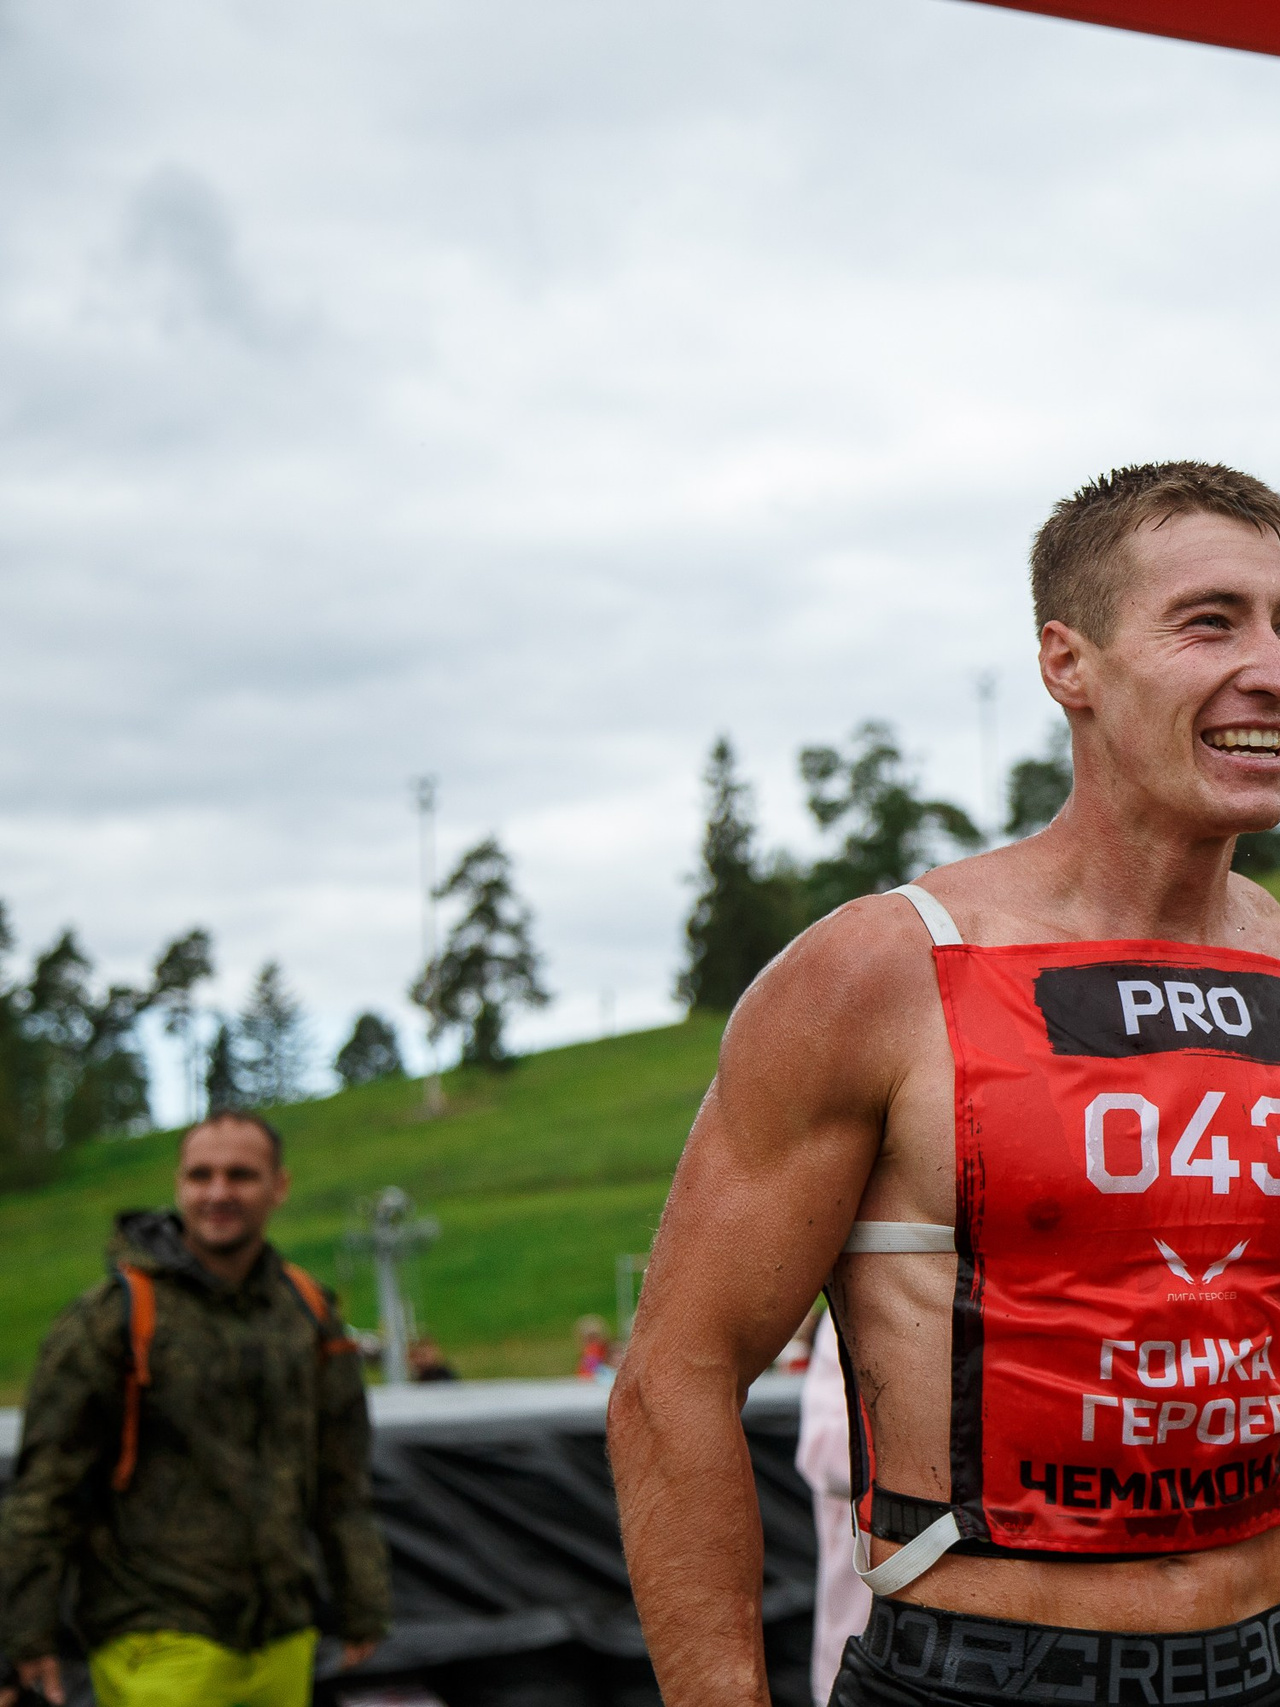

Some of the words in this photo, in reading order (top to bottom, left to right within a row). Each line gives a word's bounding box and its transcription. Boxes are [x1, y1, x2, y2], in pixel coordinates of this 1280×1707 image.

[1116, 979, 1253, 1037] PRO
[1167, 1292, 1196, 1302] ЛИГА
[1198, 1291, 1238, 1301] ГЕРОЕВ
[1100, 1335, 1277, 1388] ГОНКА
